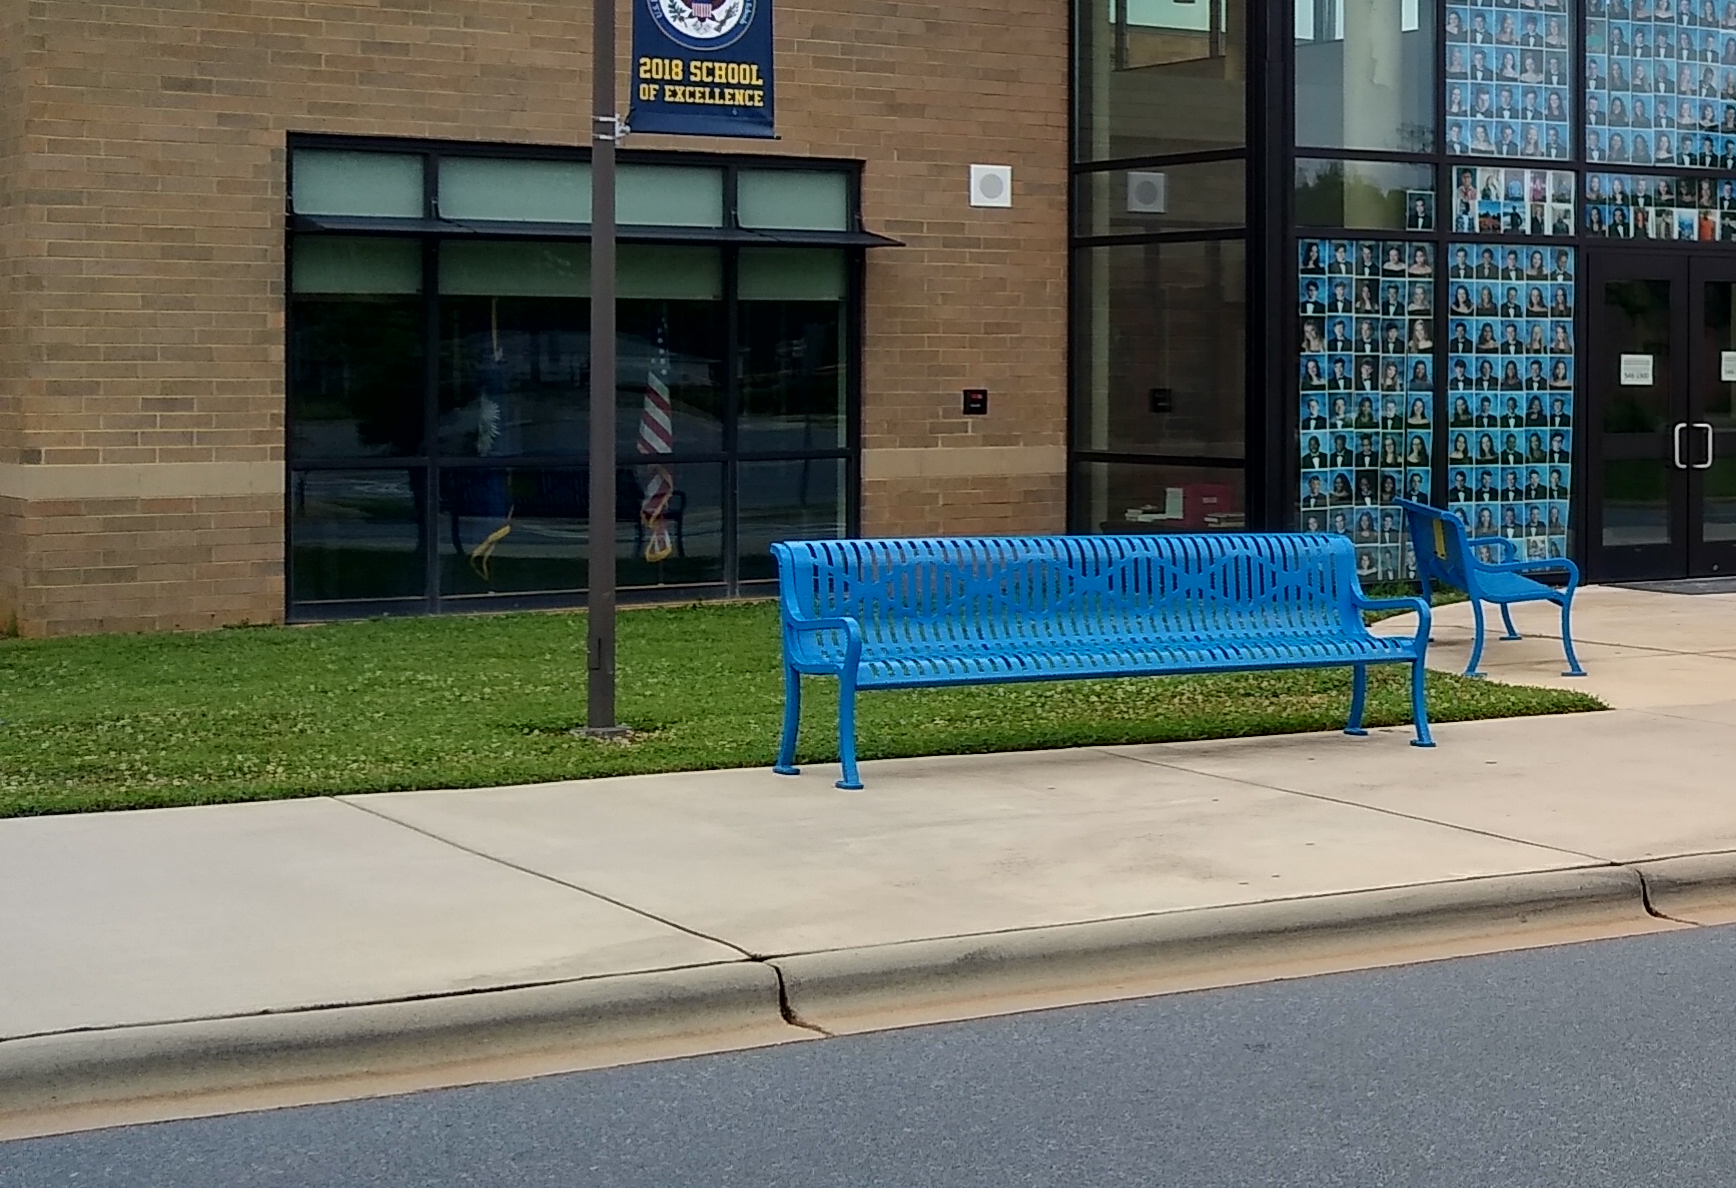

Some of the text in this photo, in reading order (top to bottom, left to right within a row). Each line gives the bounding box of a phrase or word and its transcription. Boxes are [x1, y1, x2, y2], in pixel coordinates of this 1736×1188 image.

[639, 58, 764, 85] 2018 SCHOOL
[639, 84, 764, 107] OF EXCELLENCE
